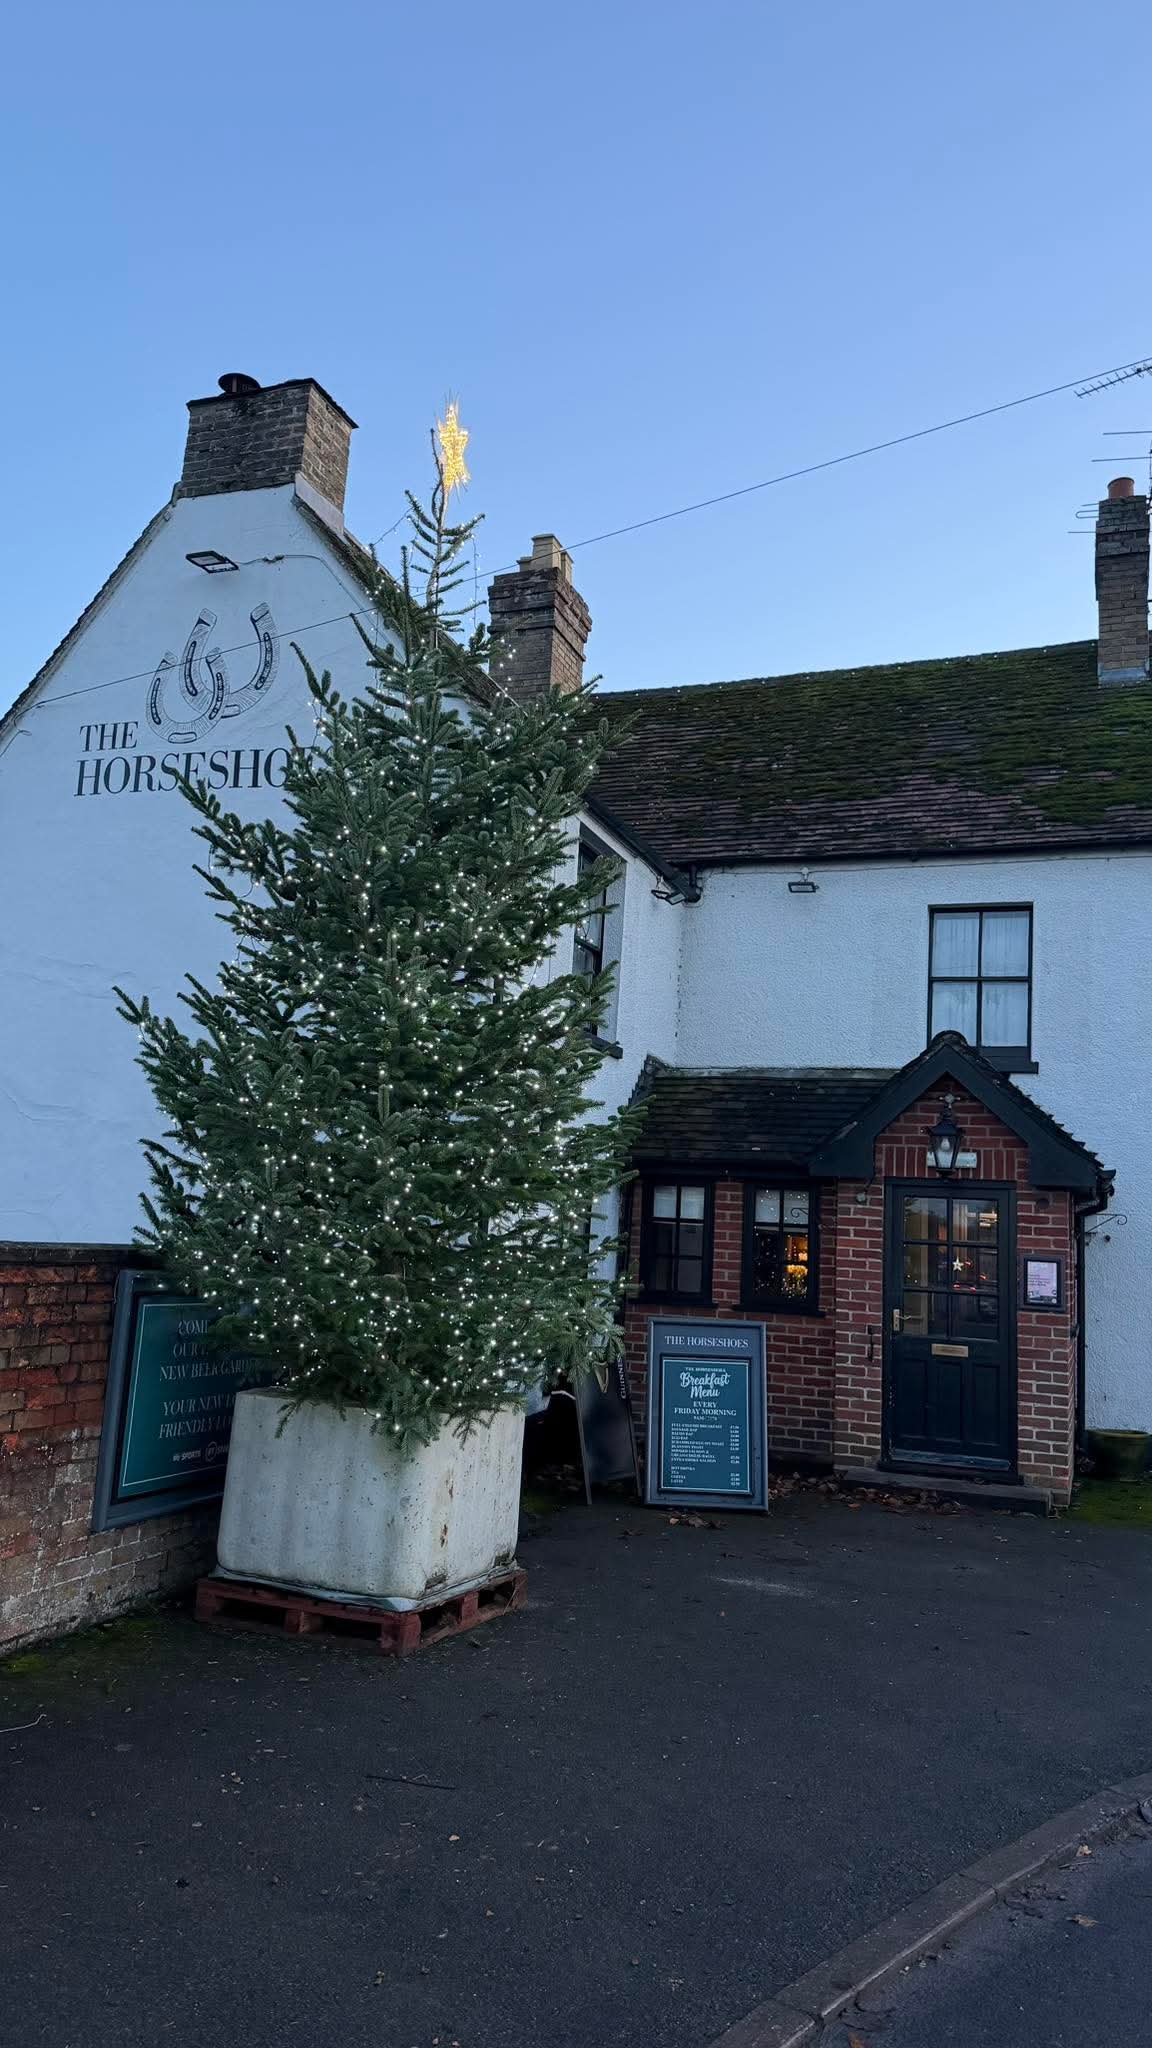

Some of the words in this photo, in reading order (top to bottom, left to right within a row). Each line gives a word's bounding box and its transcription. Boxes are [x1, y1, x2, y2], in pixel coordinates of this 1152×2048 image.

[79, 720, 139, 752] THE
[73, 747, 314, 797] HORSESHO
[664, 1335, 685, 1345] THE
[687, 1336, 749, 1348] HORSESHOES
[160, 1362, 188, 1381] NEW
[190, 1361, 218, 1378] BEER
[680, 1371, 731, 1389] Breakfast
[690, 1385, 720, 1398] Menu
[163, 1399, 196, 1416] YOUR
[674, 1407, 700, 1415] FRIDAY
[701, 1408, 737, 1416] MORNING
[159, 1416, 214, 1439] FRIENDLY
